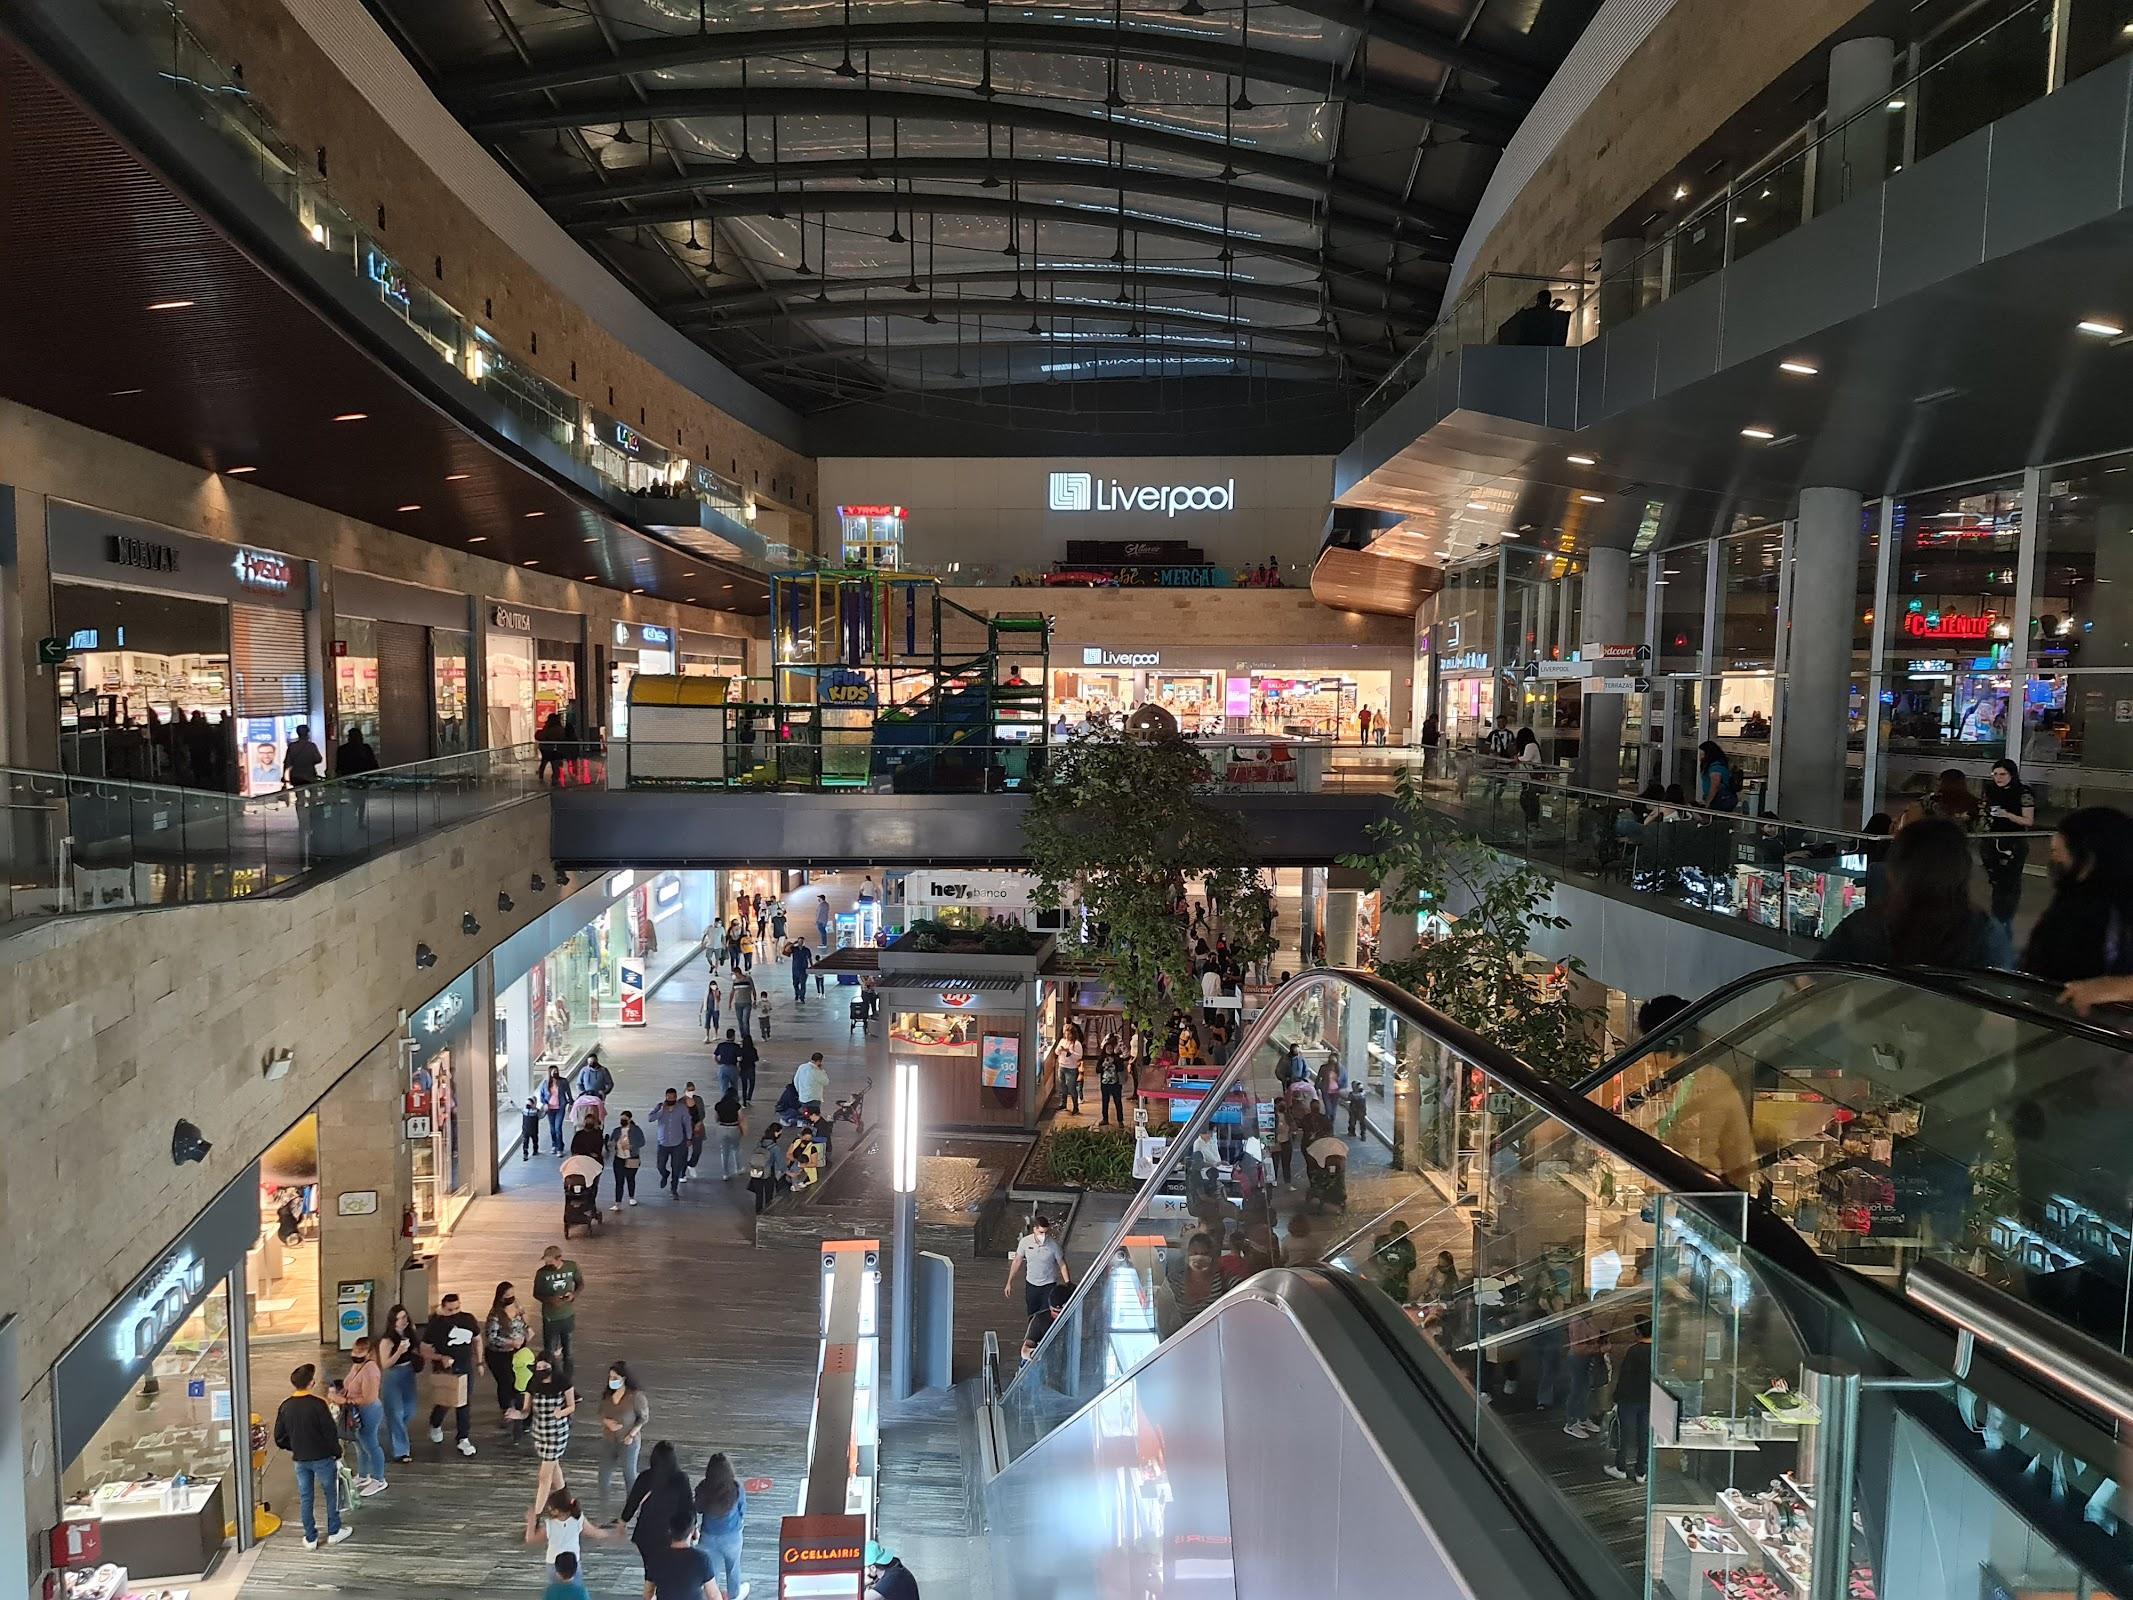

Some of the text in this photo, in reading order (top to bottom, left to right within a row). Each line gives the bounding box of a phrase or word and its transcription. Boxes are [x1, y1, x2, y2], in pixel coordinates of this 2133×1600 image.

[1097, 478, 1235, 518] Liverpool
[507, 614, 531, 631] NUTRISA
[1102, 651, 1160, 666] Liverpool
[828, 685, 869, 702] KIDS
[973, 888, 1007, 898] banco
[800, 1548, 860, 1560] CELLAIRIS
